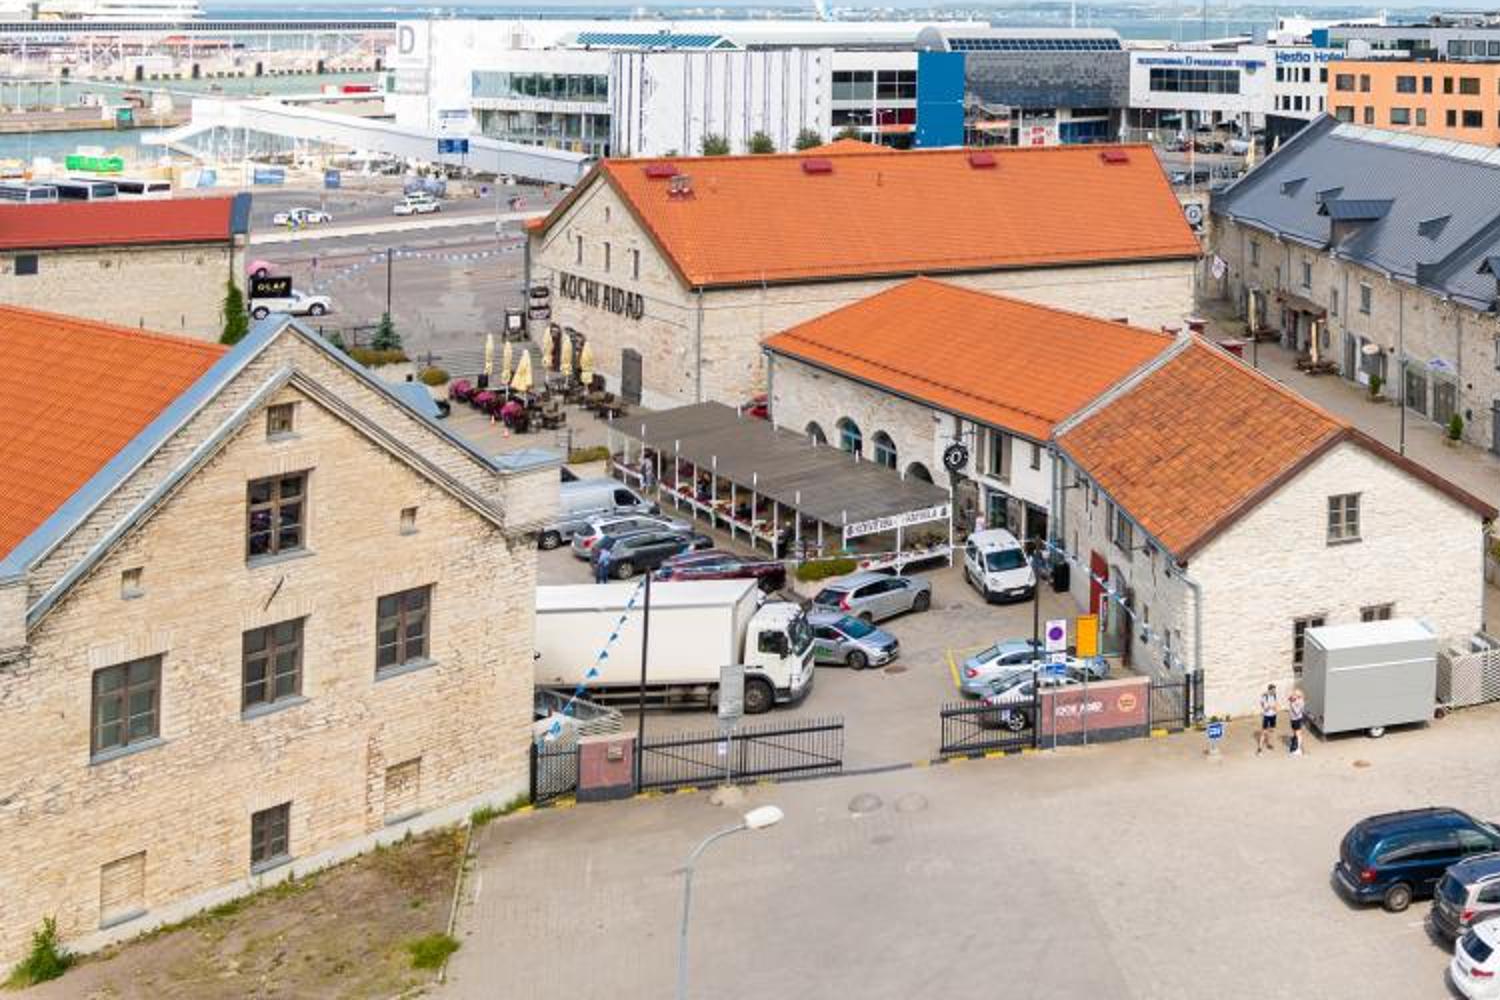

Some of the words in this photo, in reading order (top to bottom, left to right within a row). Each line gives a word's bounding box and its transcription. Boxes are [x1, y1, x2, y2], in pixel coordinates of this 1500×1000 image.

[398, 25, 415, 54] D
[1276, 50, 1311, 63] Hestia
[1314, 50, 1344, 62] Hotel
[559, 271, 600, 308] KOCHI
[602, 284, 645, 321] AIDAD
